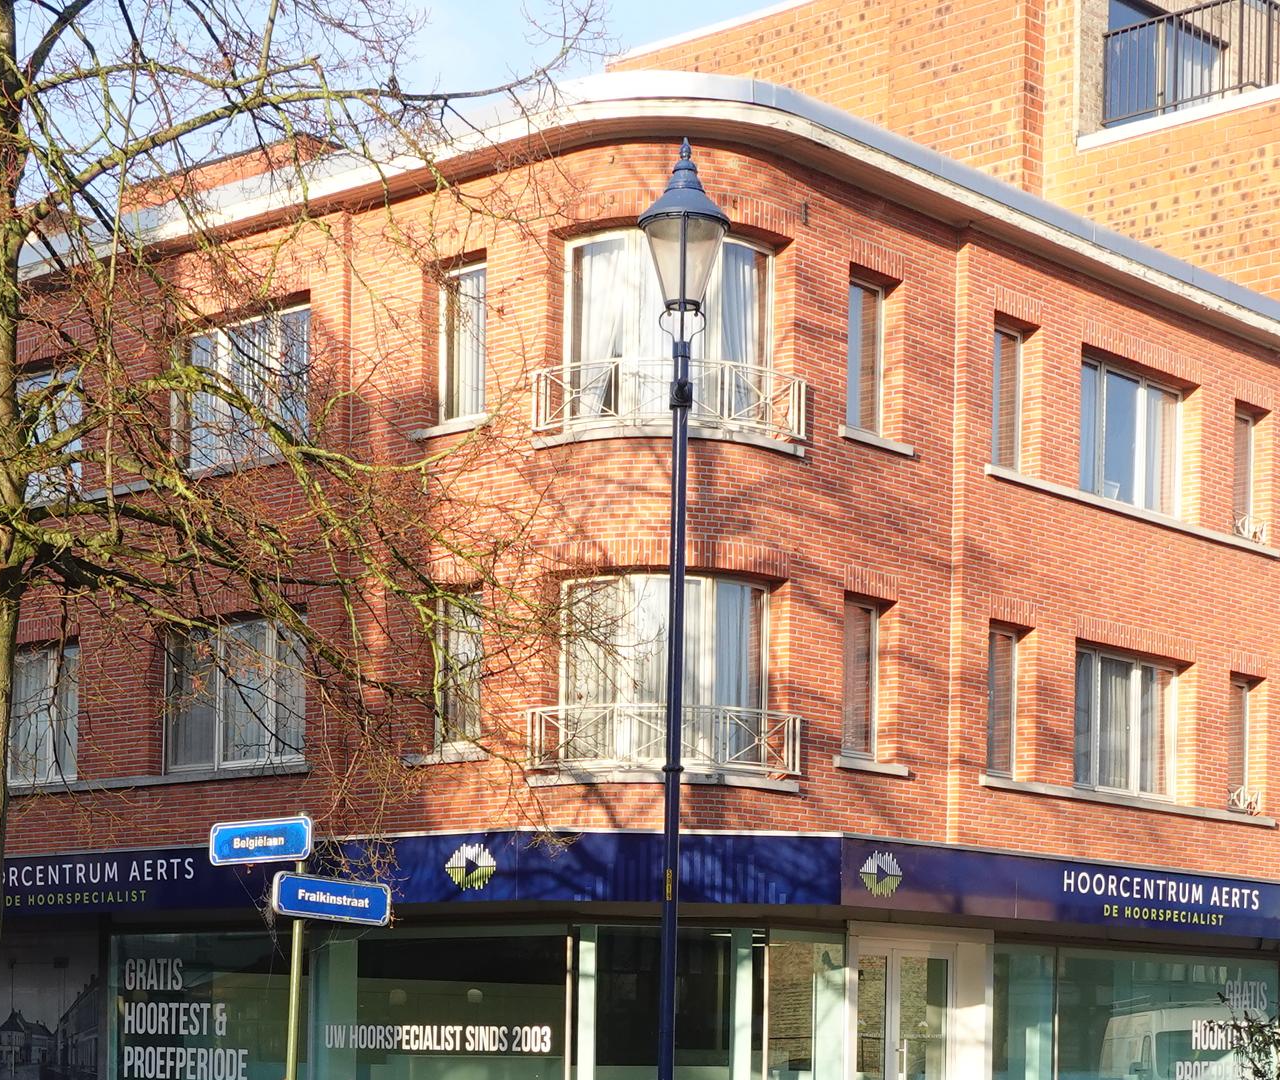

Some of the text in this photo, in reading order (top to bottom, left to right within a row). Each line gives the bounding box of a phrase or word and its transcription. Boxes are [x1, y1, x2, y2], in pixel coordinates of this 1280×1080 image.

[233, 836, 285, 850] Belgiëlaan
[3, 857, 195, 887] RCENTRUM AERTS
[5, 890, 147, 907] DE HOORSPECIALIST
[298, 888, 370, 909] Fraikinstraat
[1063, 870, 1260, 911] HOORCENTRUM AERTS
[1103, 904, 1224, 926] DE HOORSPECIALIST
[124, 958, 184, 991] GRATIS
[1225, 980, 1268, 1011] GRATIS
[124, 1002, 228, 1036] HOORTEST &
[325, 1024, 552, 1053] UW HOORSPECIALIST SINDS 2003
